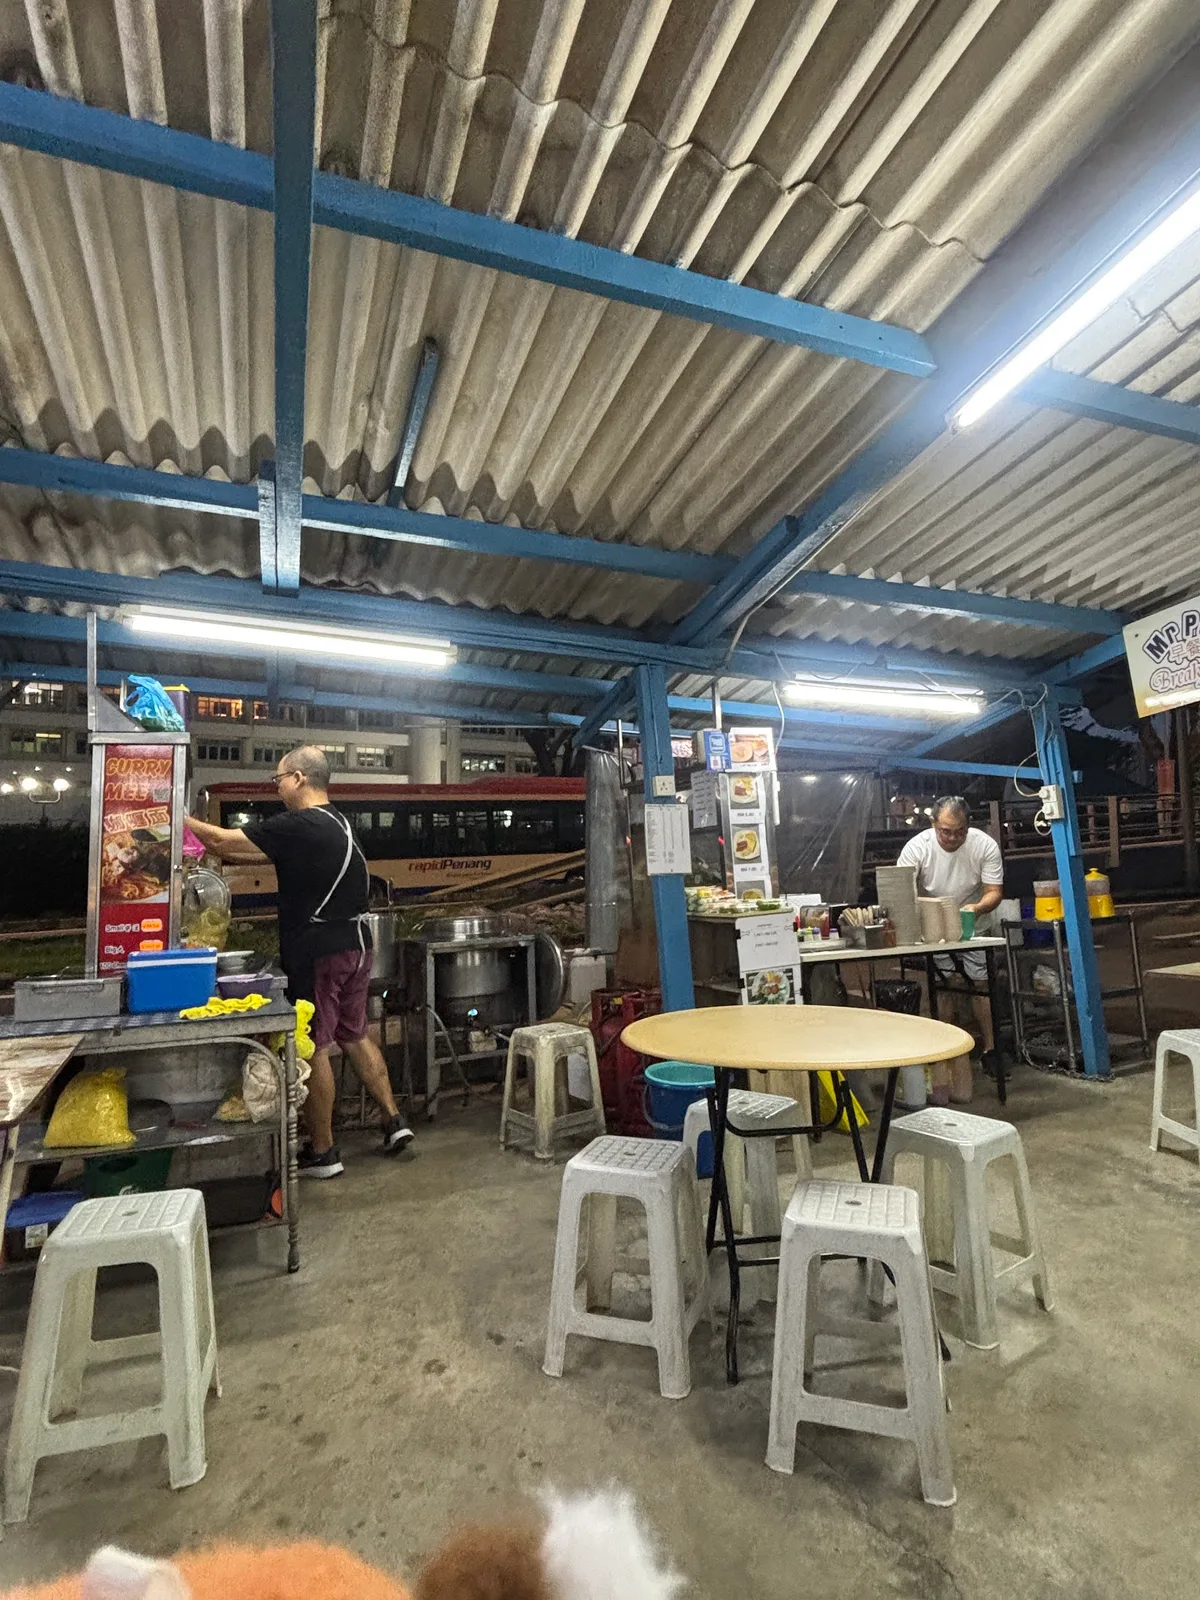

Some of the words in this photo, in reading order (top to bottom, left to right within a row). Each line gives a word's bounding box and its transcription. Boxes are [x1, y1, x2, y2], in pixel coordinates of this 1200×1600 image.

[1143, 624, 1179, 661] Mr
[106, 758, 172, 778] CURRY
[408, 859, 492, 873] rapidPenang
